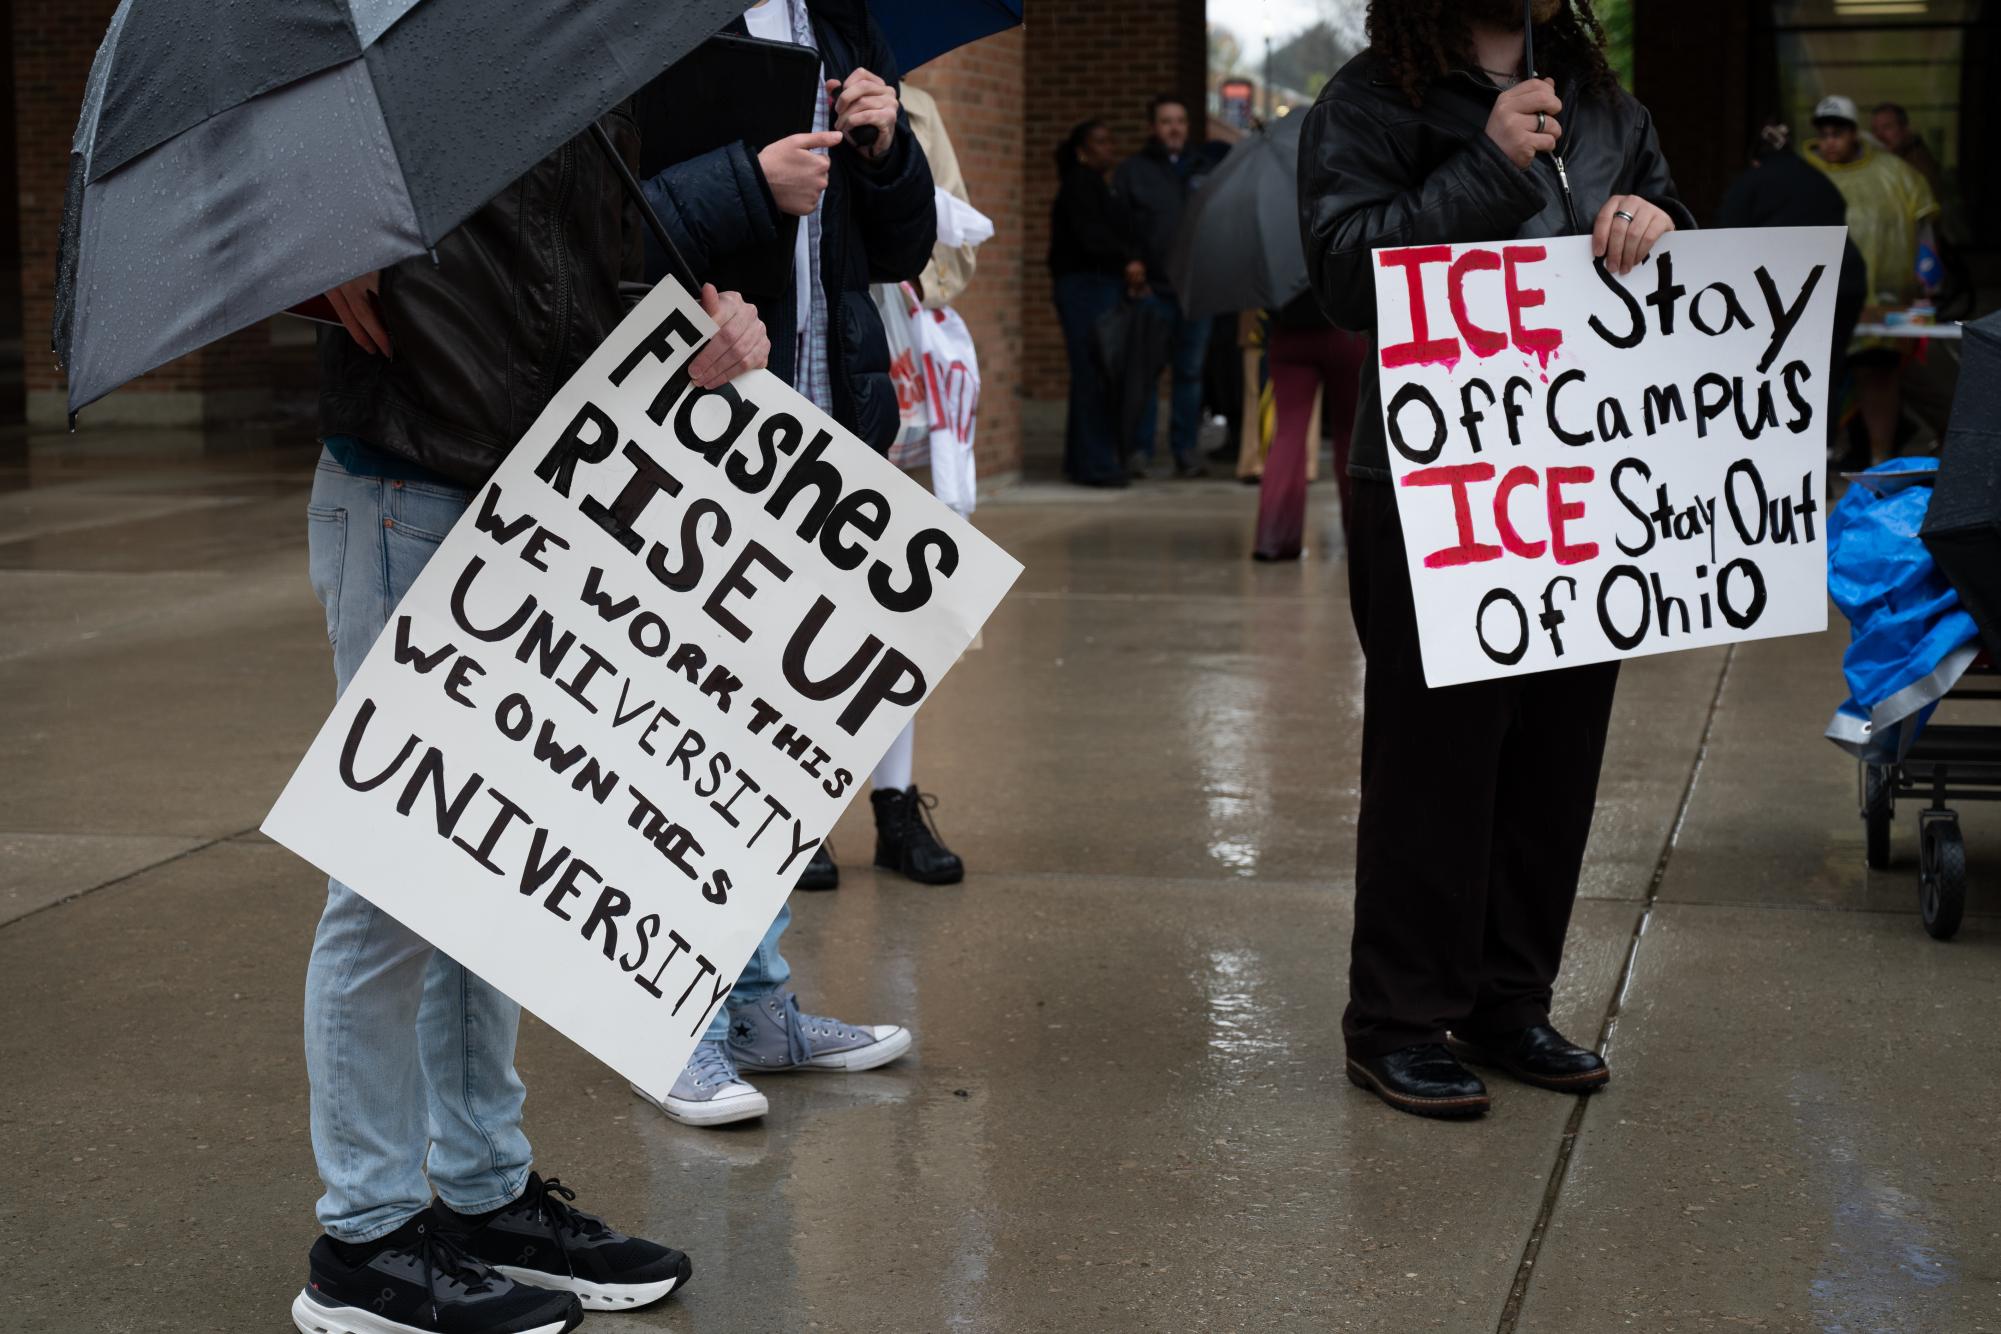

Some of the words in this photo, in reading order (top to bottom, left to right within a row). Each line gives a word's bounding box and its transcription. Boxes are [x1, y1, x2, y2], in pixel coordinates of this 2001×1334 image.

[1378, 246, 1563, 372] ICE
[1588, 251, 1826, 373] Stay
[1388, 376, 1533, 464] Off
[1547, 360, 1813, 446] Campus
[474, 483, 571, 572] WE
[580, 567, 743, 713] WORK
[747, 698, 853, 828] THIS
[534, 401, 793, 643] RISE
[782, 595, 928, 736] UP
[1401, 462, 1599, 569] ICE
[1611, 457, 1716, 563] Stay
[1724, 458, 1818, 546] Out
[1476, 575, 1577, 665] Of
[395, 615, 487, 708] WE
[495, 693, 620, 804] OWN
[628, 785, 733, 905] THIS
[451, 555, 822, 876] UNIVERSITY
[340, 699, 731, 1038] UNIVERSITY
